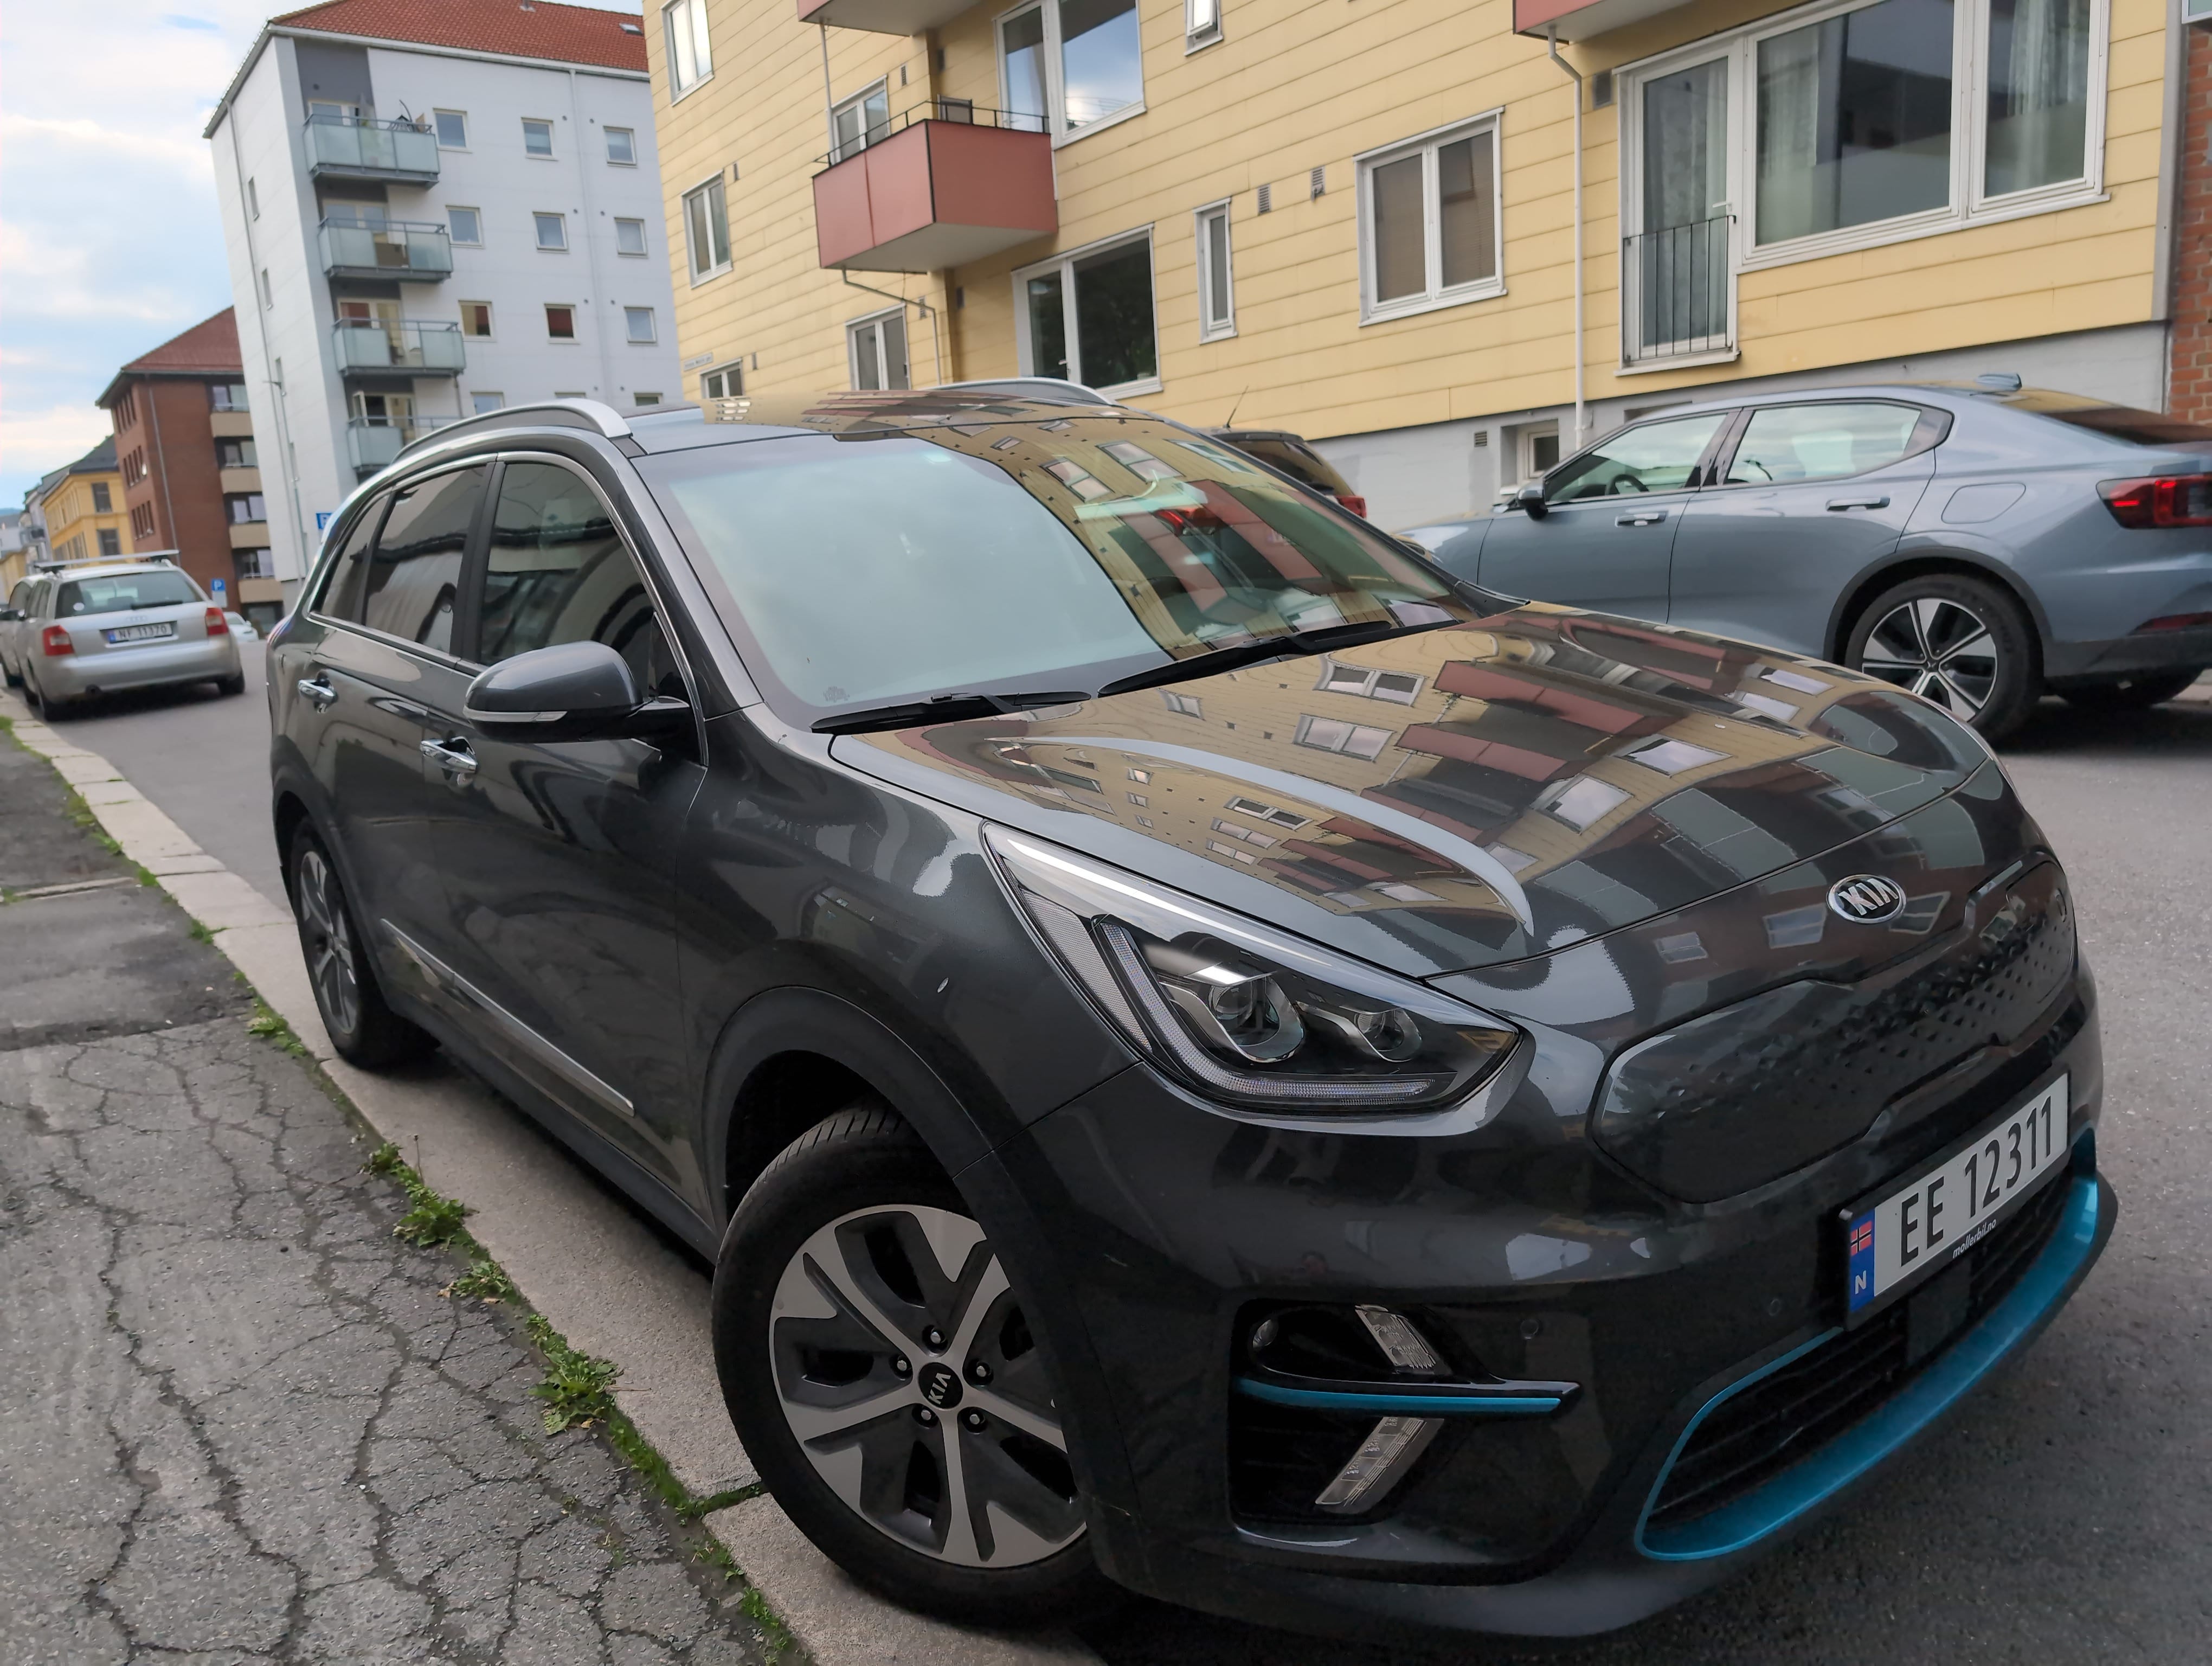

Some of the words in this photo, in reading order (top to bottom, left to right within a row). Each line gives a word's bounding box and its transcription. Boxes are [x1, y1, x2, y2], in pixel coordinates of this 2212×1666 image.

[214, 580, 222, 591] P
[1838, 878, 1899, 916] KIA
[1900, 1175, 1945, 1267] EE
[1964, 1095, 2052, 1219] 12311
[1952, 1219, 1996, 1259] mollerbil.no
[1854, 1270, 1867, 1295] N
[928, 1373, 951, 1405] KIA
